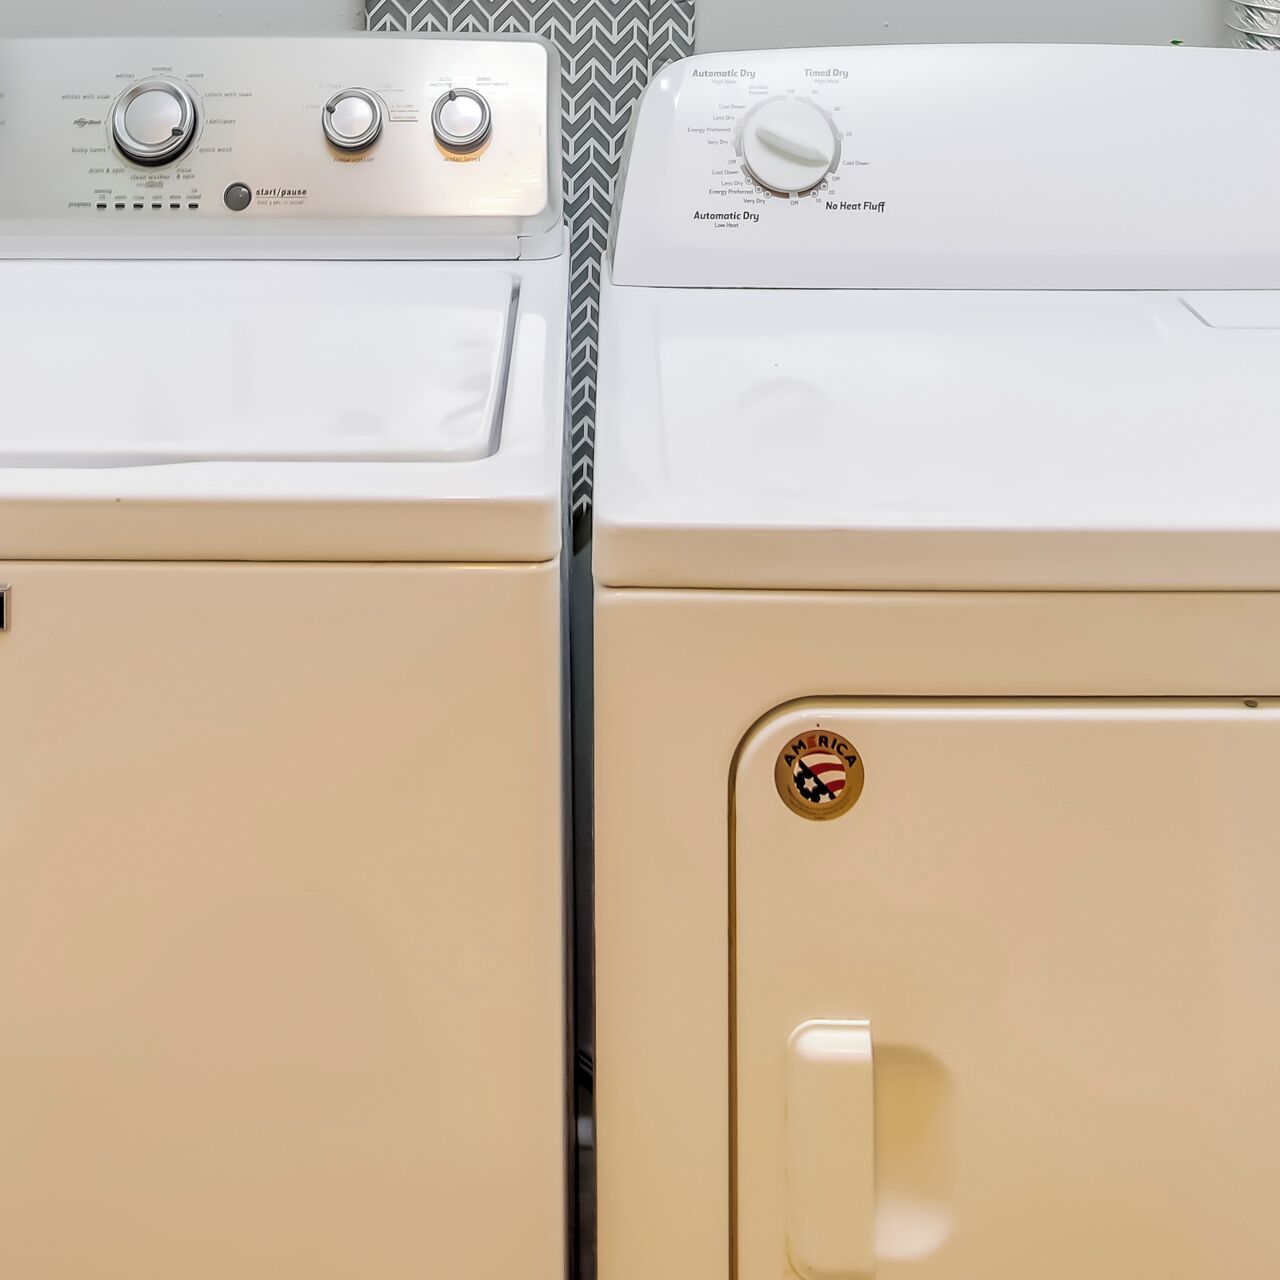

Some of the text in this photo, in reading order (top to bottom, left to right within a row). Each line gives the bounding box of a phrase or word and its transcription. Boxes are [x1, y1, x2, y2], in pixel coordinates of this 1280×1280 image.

[692, 69, 756, 80] Automatic Dry
[804, 68, 849, 79] Timed Dry
[255, 187, 308, 198] start/pause
[825, 201, 886, 213] No Heat Fluff
[693, 210, 760, 223] Automatic Dry
[784, 735, 857, 768] AMERICA
